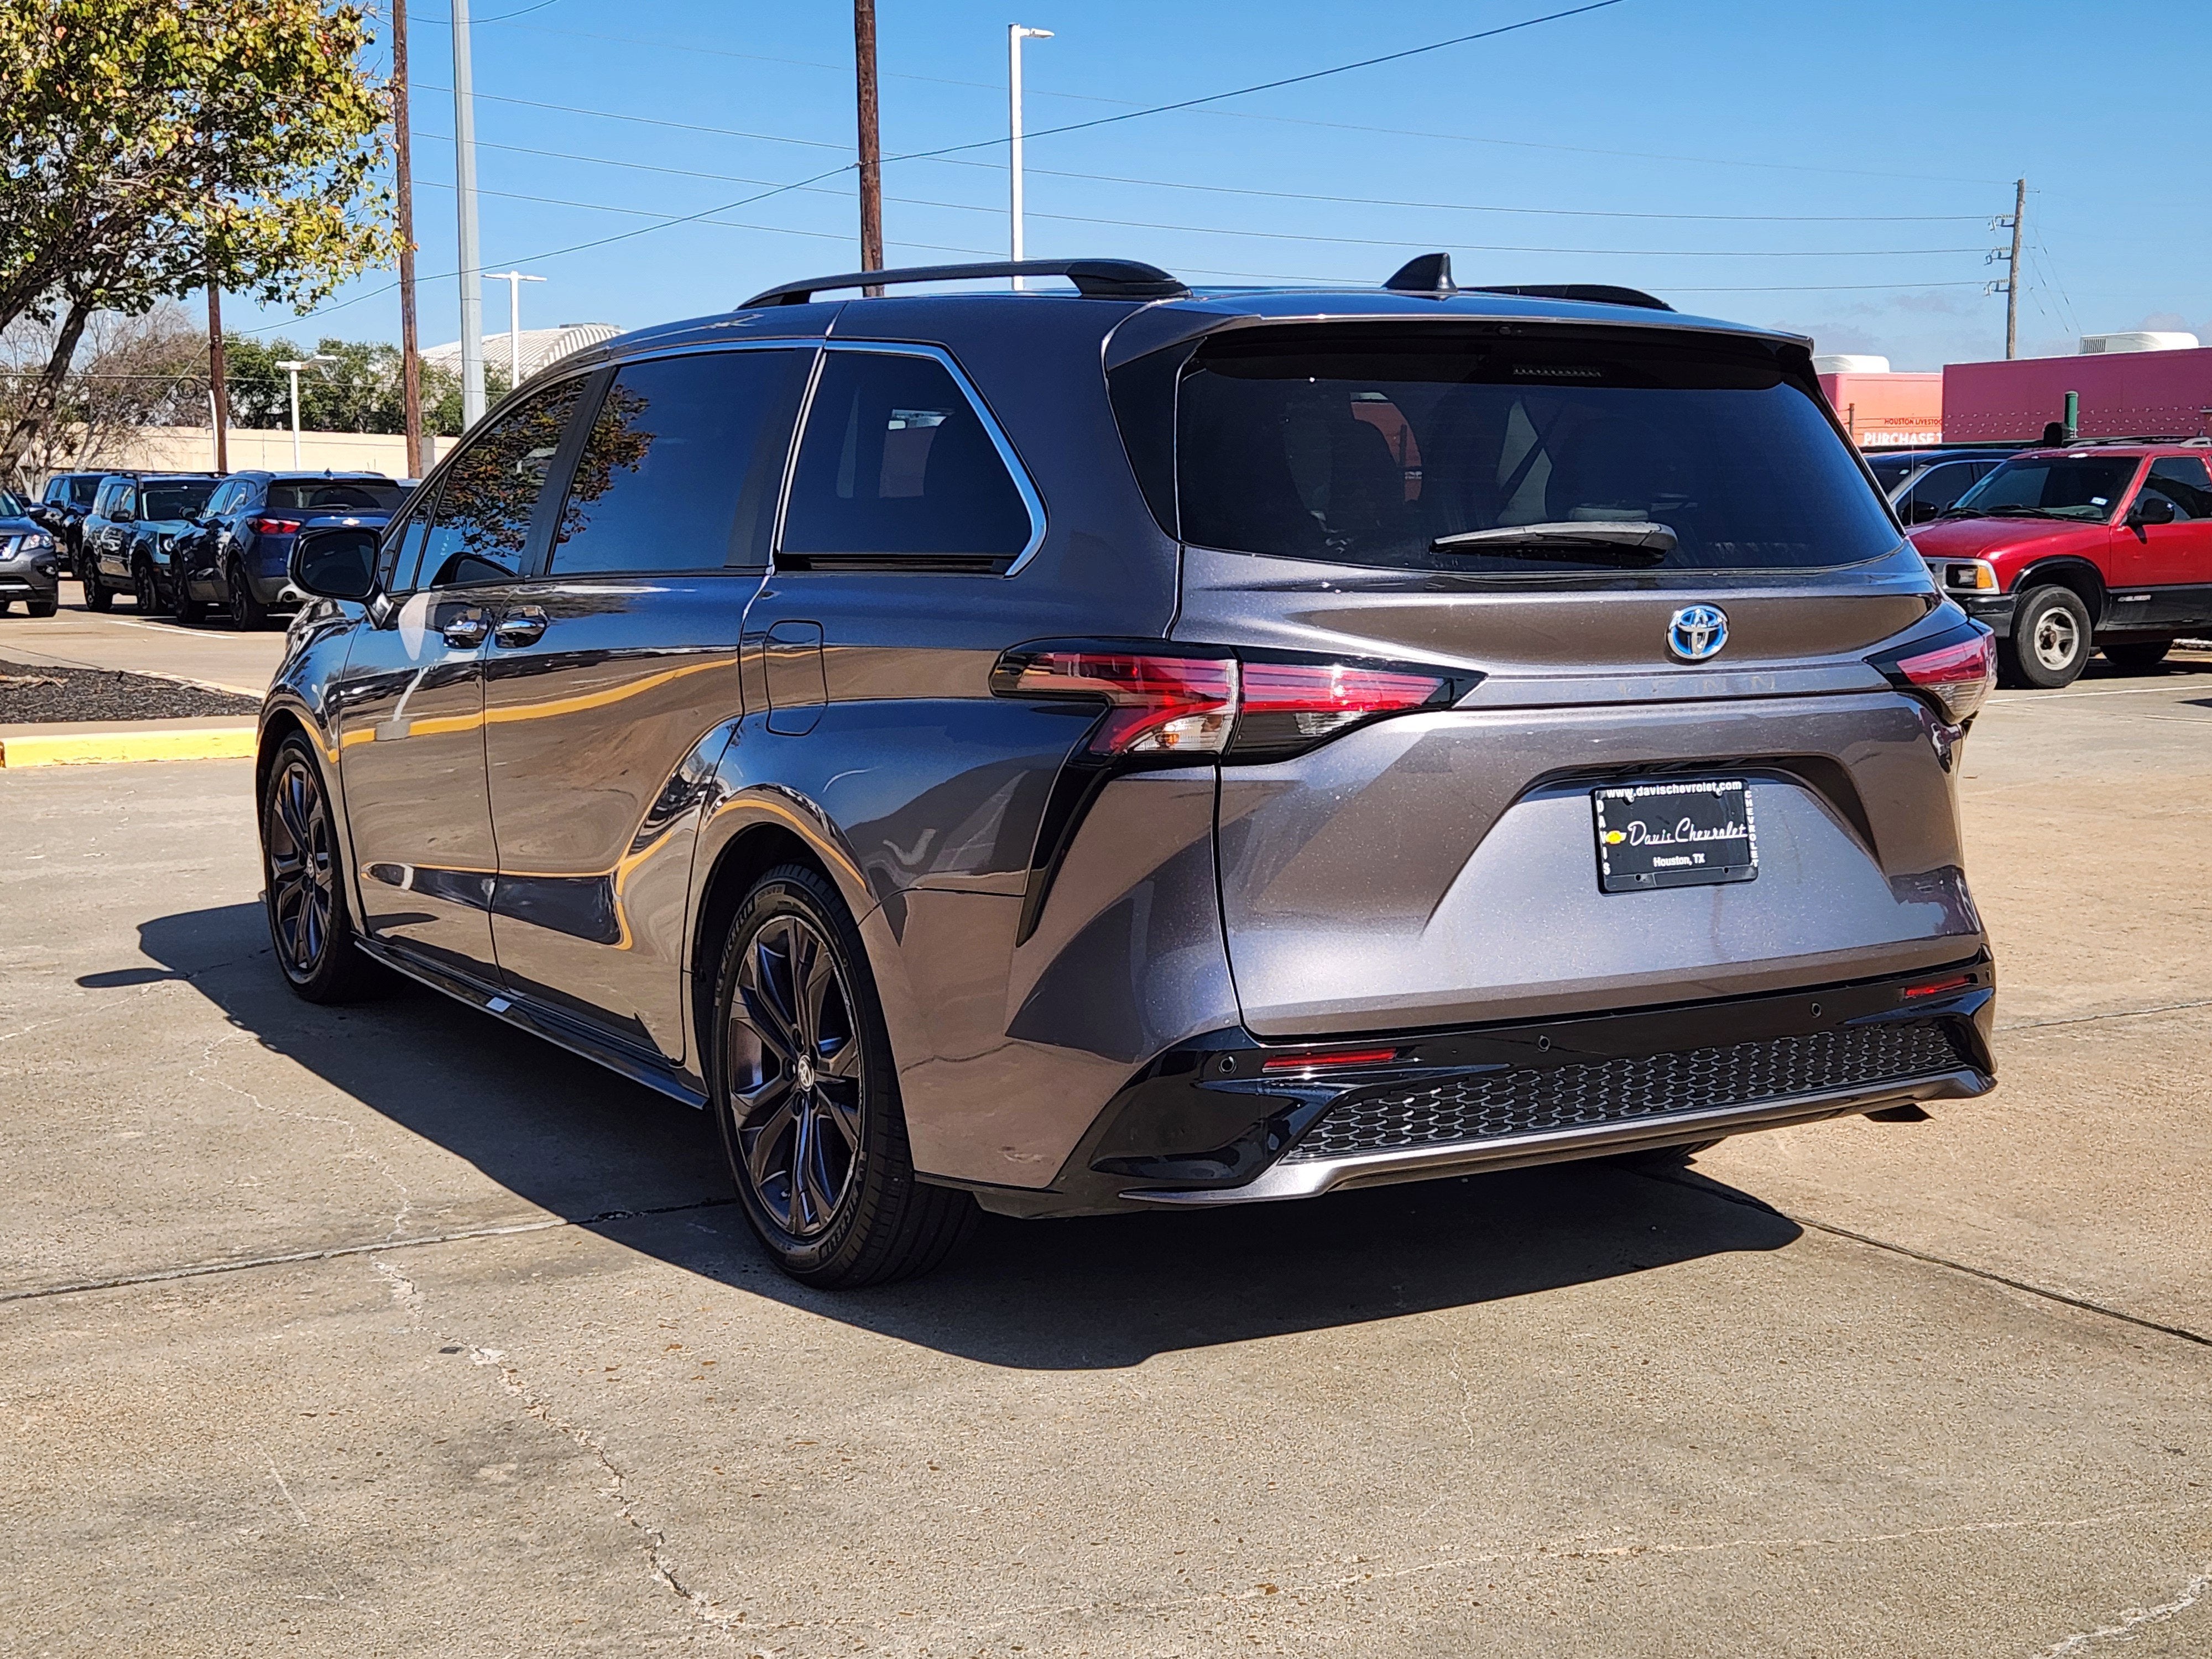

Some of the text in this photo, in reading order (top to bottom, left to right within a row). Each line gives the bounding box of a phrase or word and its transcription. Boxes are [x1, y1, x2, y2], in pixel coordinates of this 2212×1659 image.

[1864, 432, 1934, 445] PURCHASE
[1606, 781, 1742, 798] www.davischevrolet.com
[1597, 800, 1610, 875] DAVIS
[1627, 817, 1748, 846] Davis Chevrolet
[1744, 790, 1759, 867] CHEVROLET
[1653, 853, 1706, 867] Houston, TX
[721, 899, 753, 974] MICHELIN
